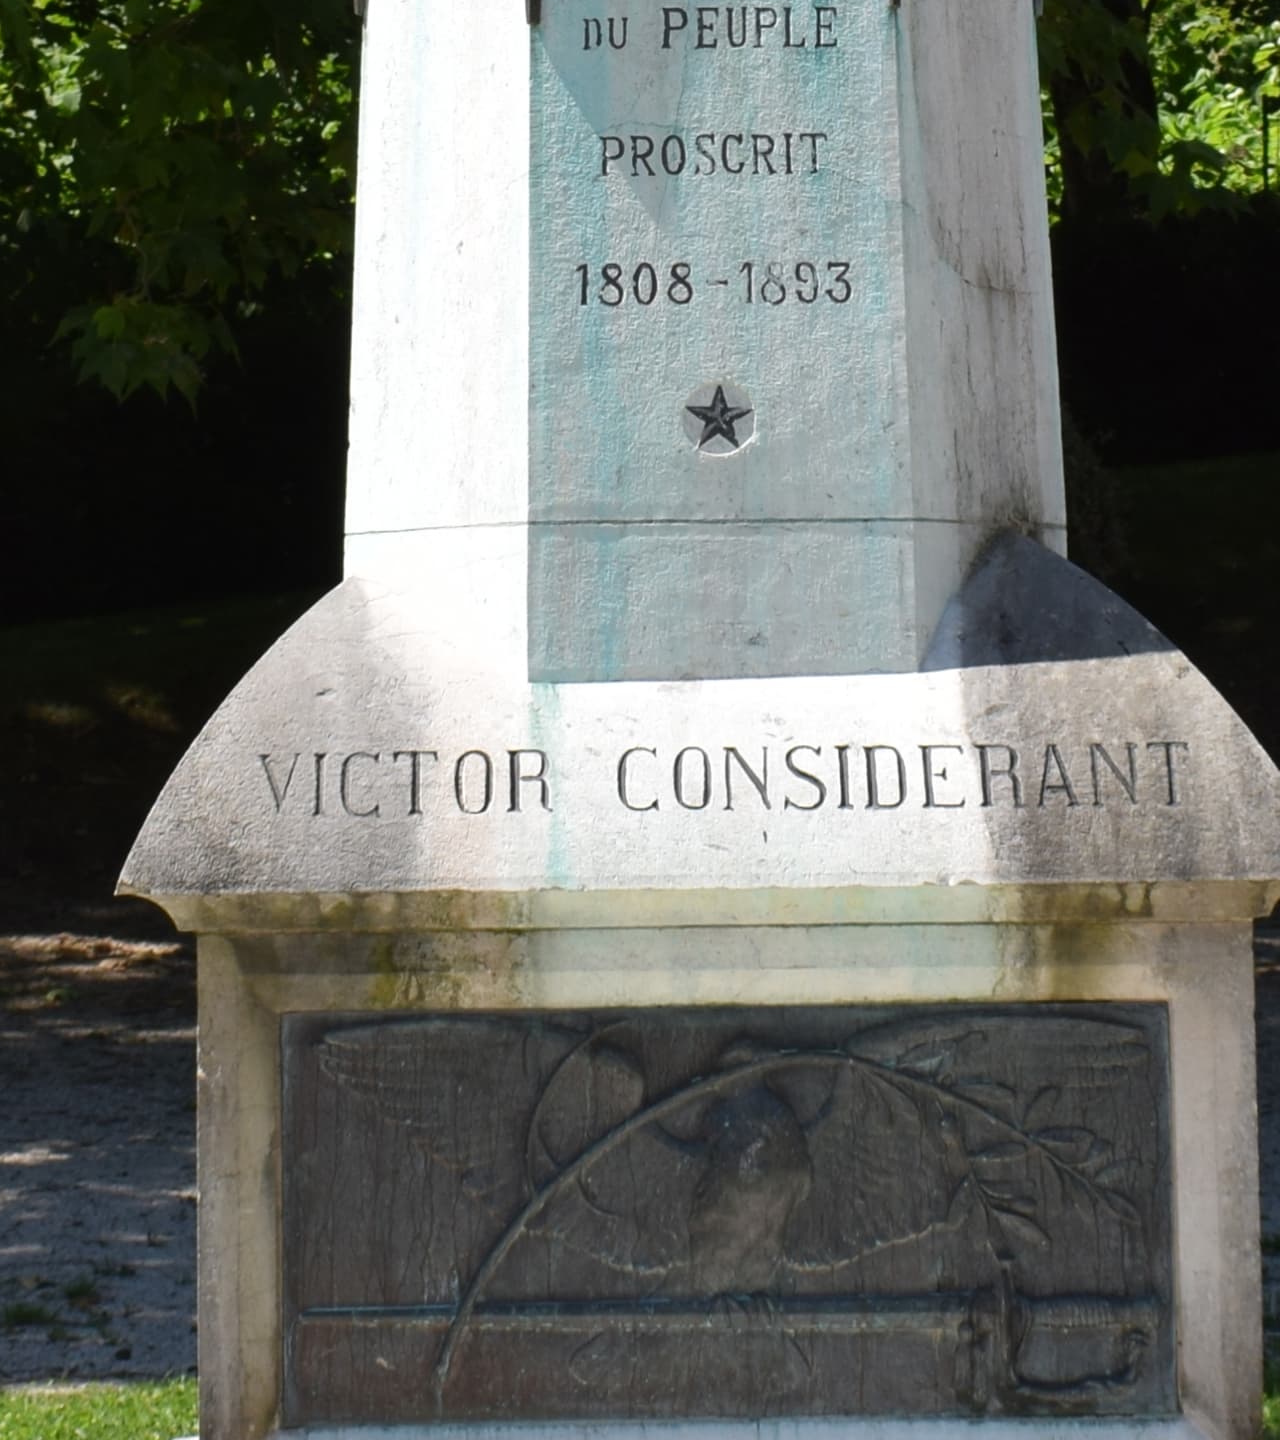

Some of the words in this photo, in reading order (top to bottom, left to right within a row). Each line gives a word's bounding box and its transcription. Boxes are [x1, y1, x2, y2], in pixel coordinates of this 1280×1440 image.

[582, 14, 628, 51] DU
[660, 5, 839, 51] PEUPLE
[599, 132, 829, 178] PROSCRIT
[258, 746, 554, 818] VICTOR
[616, 737, 1191, 814] CONSIDERANT
